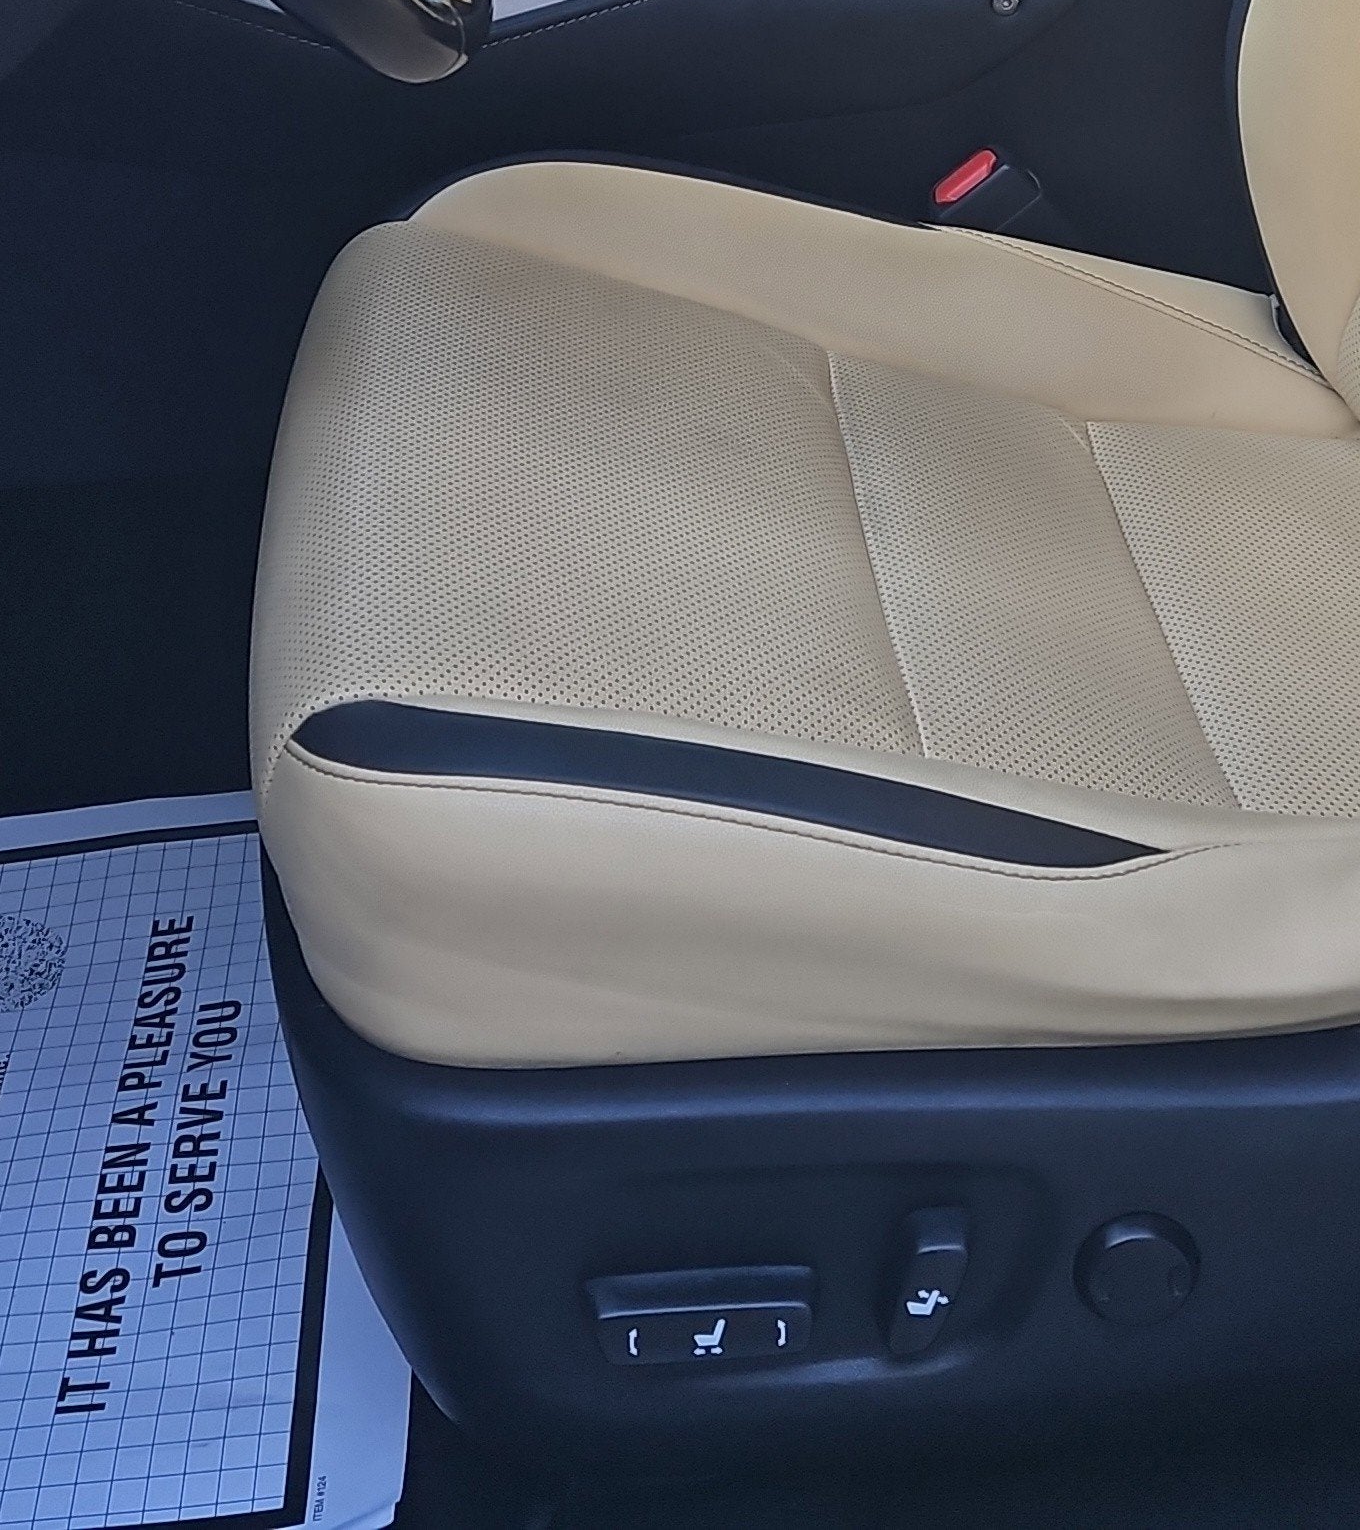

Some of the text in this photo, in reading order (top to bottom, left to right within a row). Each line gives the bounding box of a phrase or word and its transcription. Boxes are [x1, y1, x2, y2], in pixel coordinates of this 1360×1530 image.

[55, 914, 195, 1415] IT HAS BEEN A PLEASURE
[152, 999, 242, 1288] TO SERVE YOU
[313, 1498, 324, 1522] ITEM
